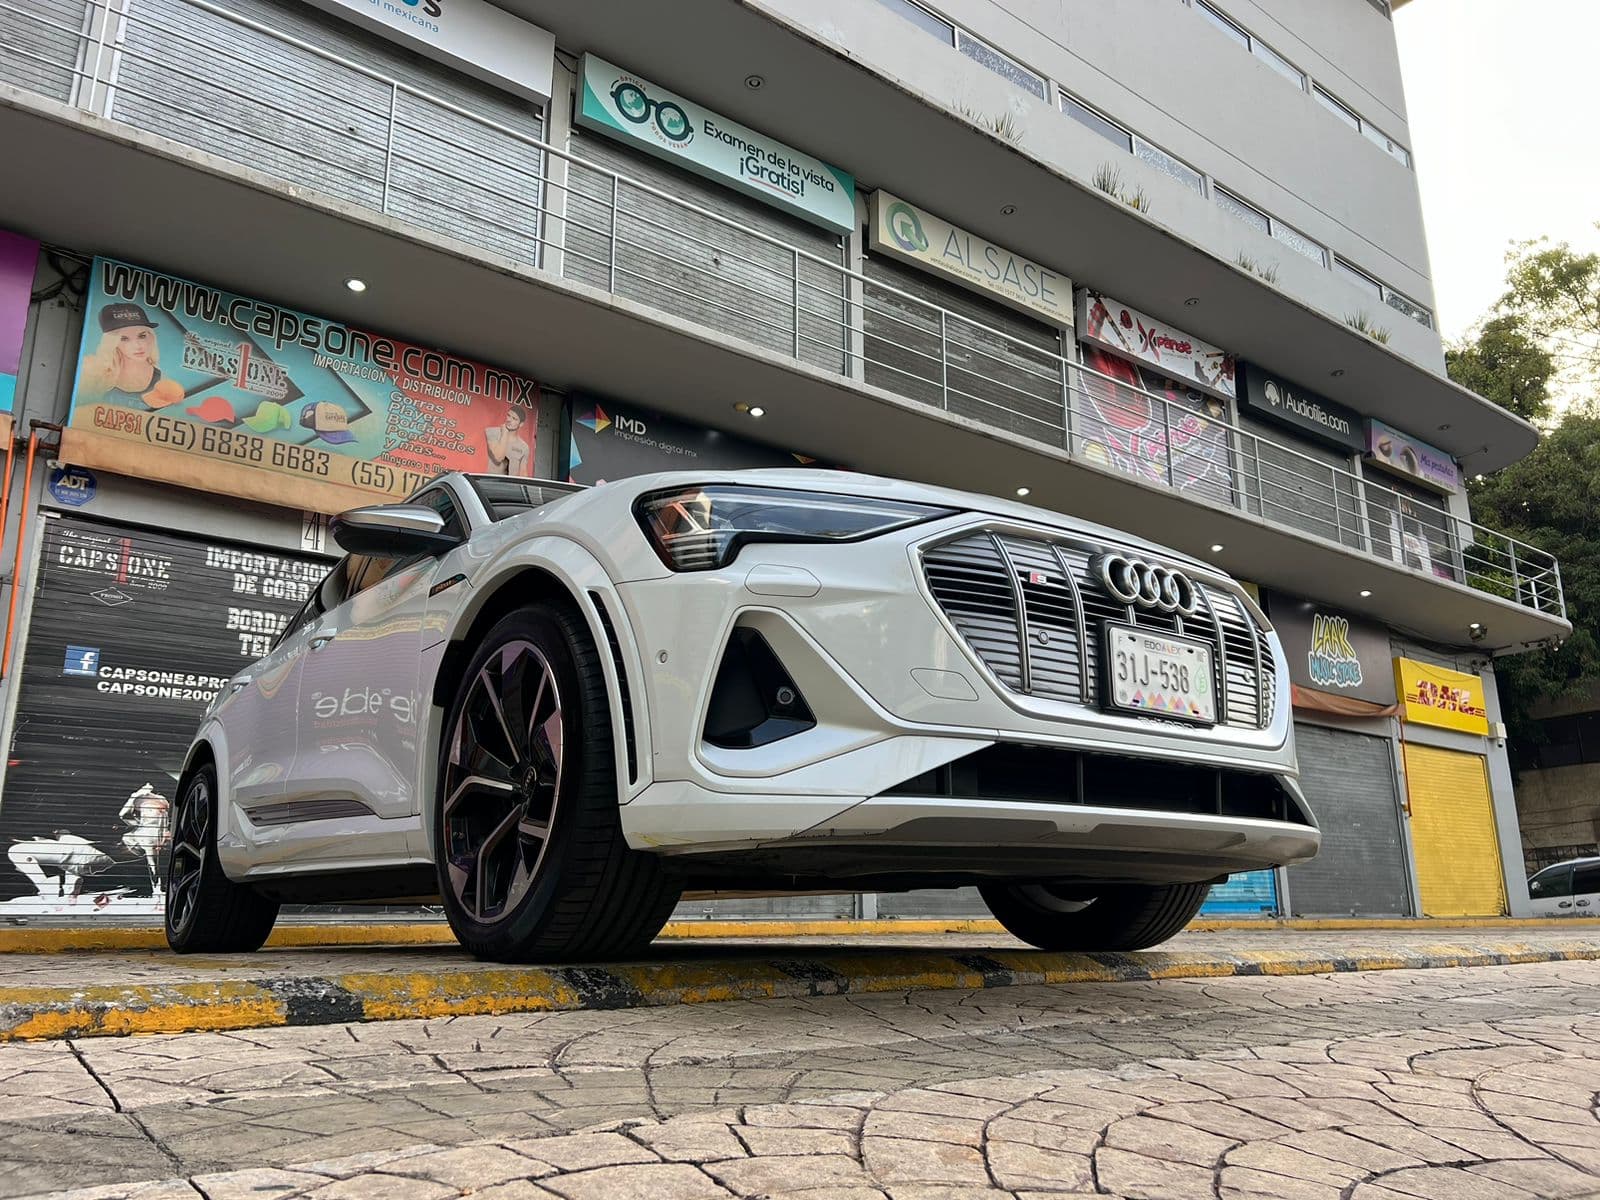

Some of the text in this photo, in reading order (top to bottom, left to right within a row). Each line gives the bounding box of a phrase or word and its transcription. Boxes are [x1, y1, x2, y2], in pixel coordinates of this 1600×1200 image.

[383, 2, 439, 33] mexicana
[703, 119, 835, 193] Examen de la vista
[739, 156, 805, 197] ¡Gratis!
[942, 228, 1058, 307] ALSASE
[102, 260, 535, 409] www.capsone.com.mx
[391, 374, 399, 386] Y
[388, 402, 458, 428] Playeras
[389, 390, 445, 414] Gorras
[385, 424, 476, 456] Ponchados
[386, 413, 466, 441] Bordados
[615, 414, 647, 436] IMD
[93, 405, 143, 436] CAPS1
[145, 415, 197, 450] (55)
[201, 427, 264, 462] 6838
[272, 441, 331, 477] 6683
[351, 460, 395, 493] (55)
[383, 437, 396, 450] y
[658, 441, 684, 455] digital
[56, 473, 91, 491] ADT
[424, 463, 431, 474] y
[303, 510, 321, 551] 4
[232, 572, 318, 602] DE GORR
[226, 606, 294, 636] BORDA
[1312, 614, 1357, 660] LAAK
[1116, 651, 1190, 695] 31J-538
[1310, 656, 1362, 685] MUSIC STORE
